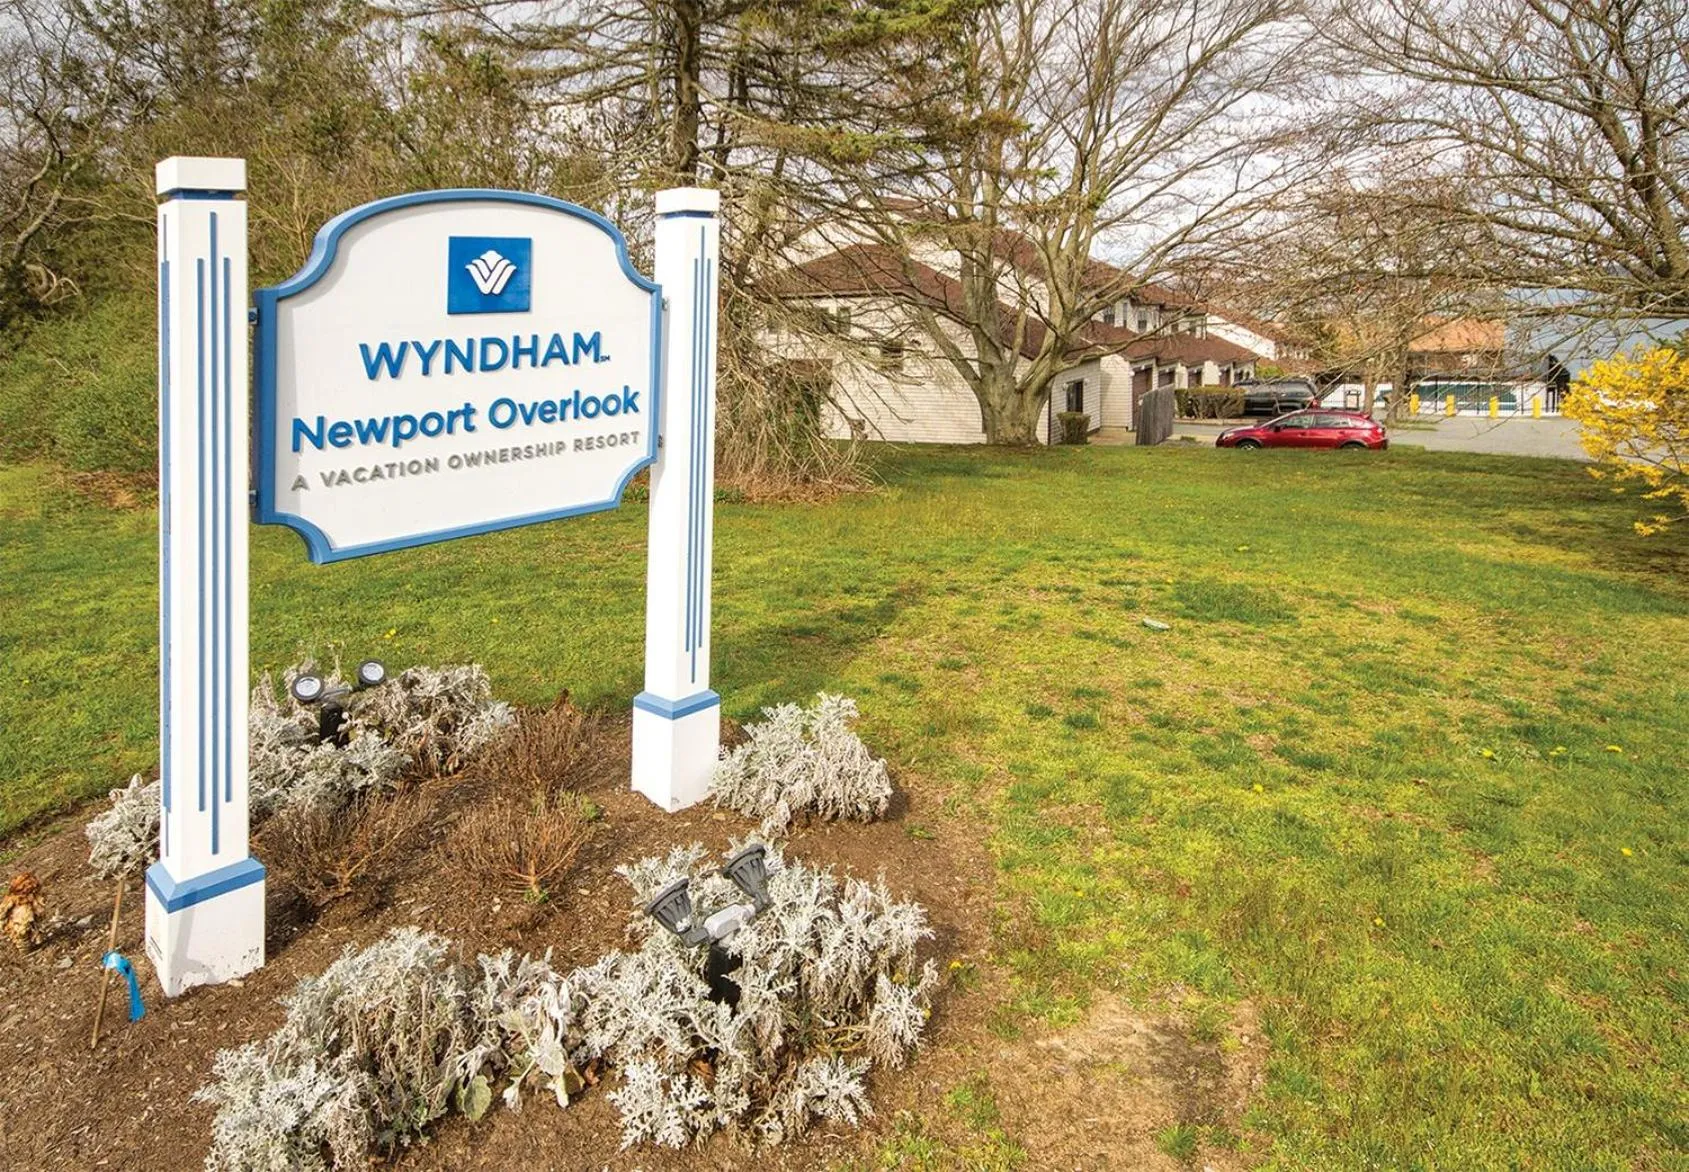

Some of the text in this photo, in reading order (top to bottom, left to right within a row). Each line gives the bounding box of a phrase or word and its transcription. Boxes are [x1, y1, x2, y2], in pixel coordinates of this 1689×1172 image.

[359, 331, 600, 381] WYNDHAM
[292, 385, 640, 453] Newport Overlook
[291, 430, 641, 492] A VACATION OWNERSHIP RESORT
